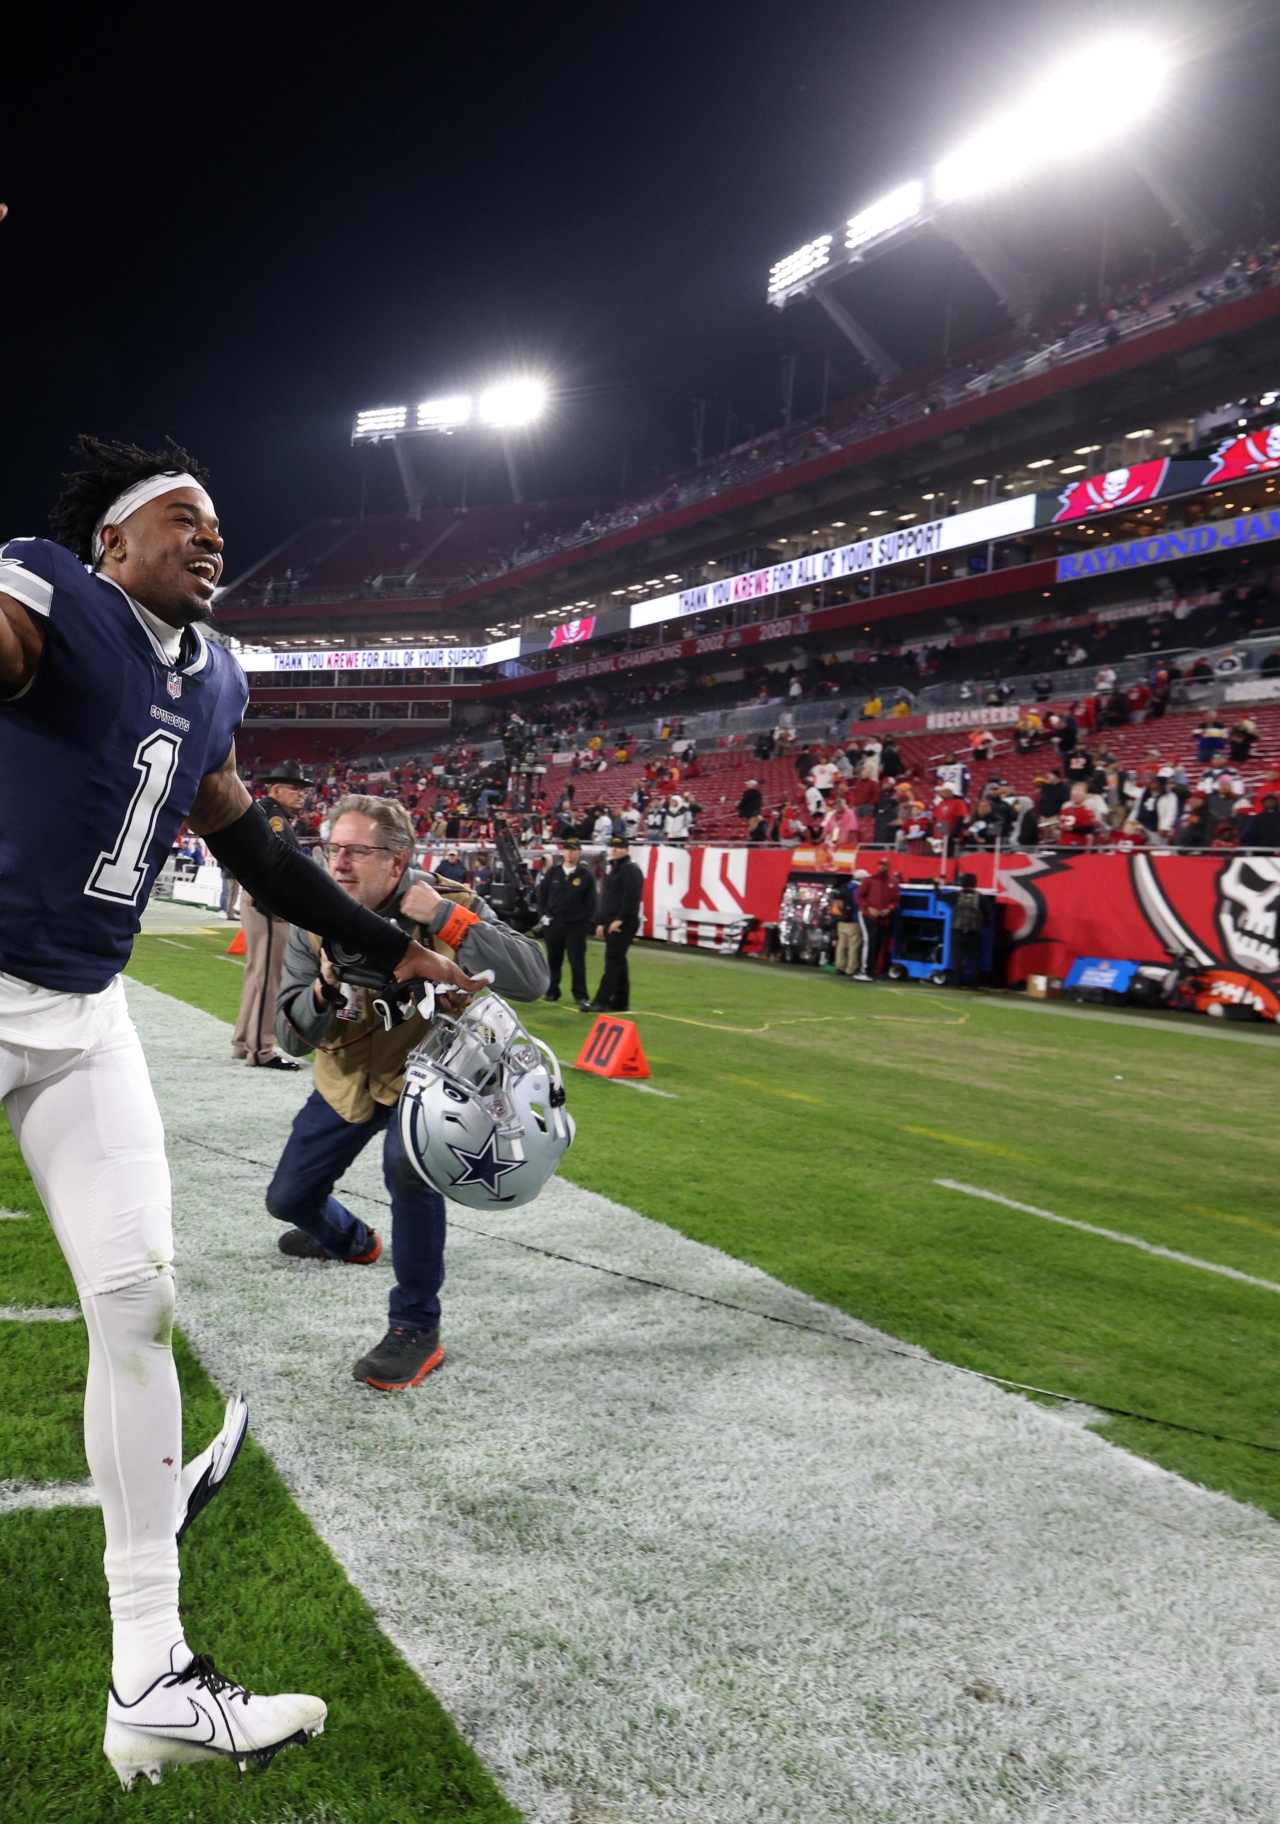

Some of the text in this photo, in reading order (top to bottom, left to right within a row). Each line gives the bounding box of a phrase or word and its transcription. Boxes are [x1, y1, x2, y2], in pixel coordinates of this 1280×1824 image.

[678, 522, 943, 616] THANK YOU KREWE FOR ALL OF YOUR SUPPORT
[1057, 526, 1217, 582] RAYMOND
[758, 621, 792, 641] 2020
[274, 654, 303, 670] THANK
[307, 653, 324, 669] YOU
[327, 652, 358, 668] KREWE
[361, 652, 379, 668] FOR
[382, 651, 400, 667] ALL
[403, 651, 415, 667] OF
[419, 650, 444, 667] YOUR
[556, 635, 724, 682] SUPER BOWL CHAMPIONS 2002
[150, 704, 190, 732] COWBOYS
[926, 705, 1020, 730] BUCCANEERS
[83, 728, 183, 907] 1
[584, 1022, 624, 1067] 10
